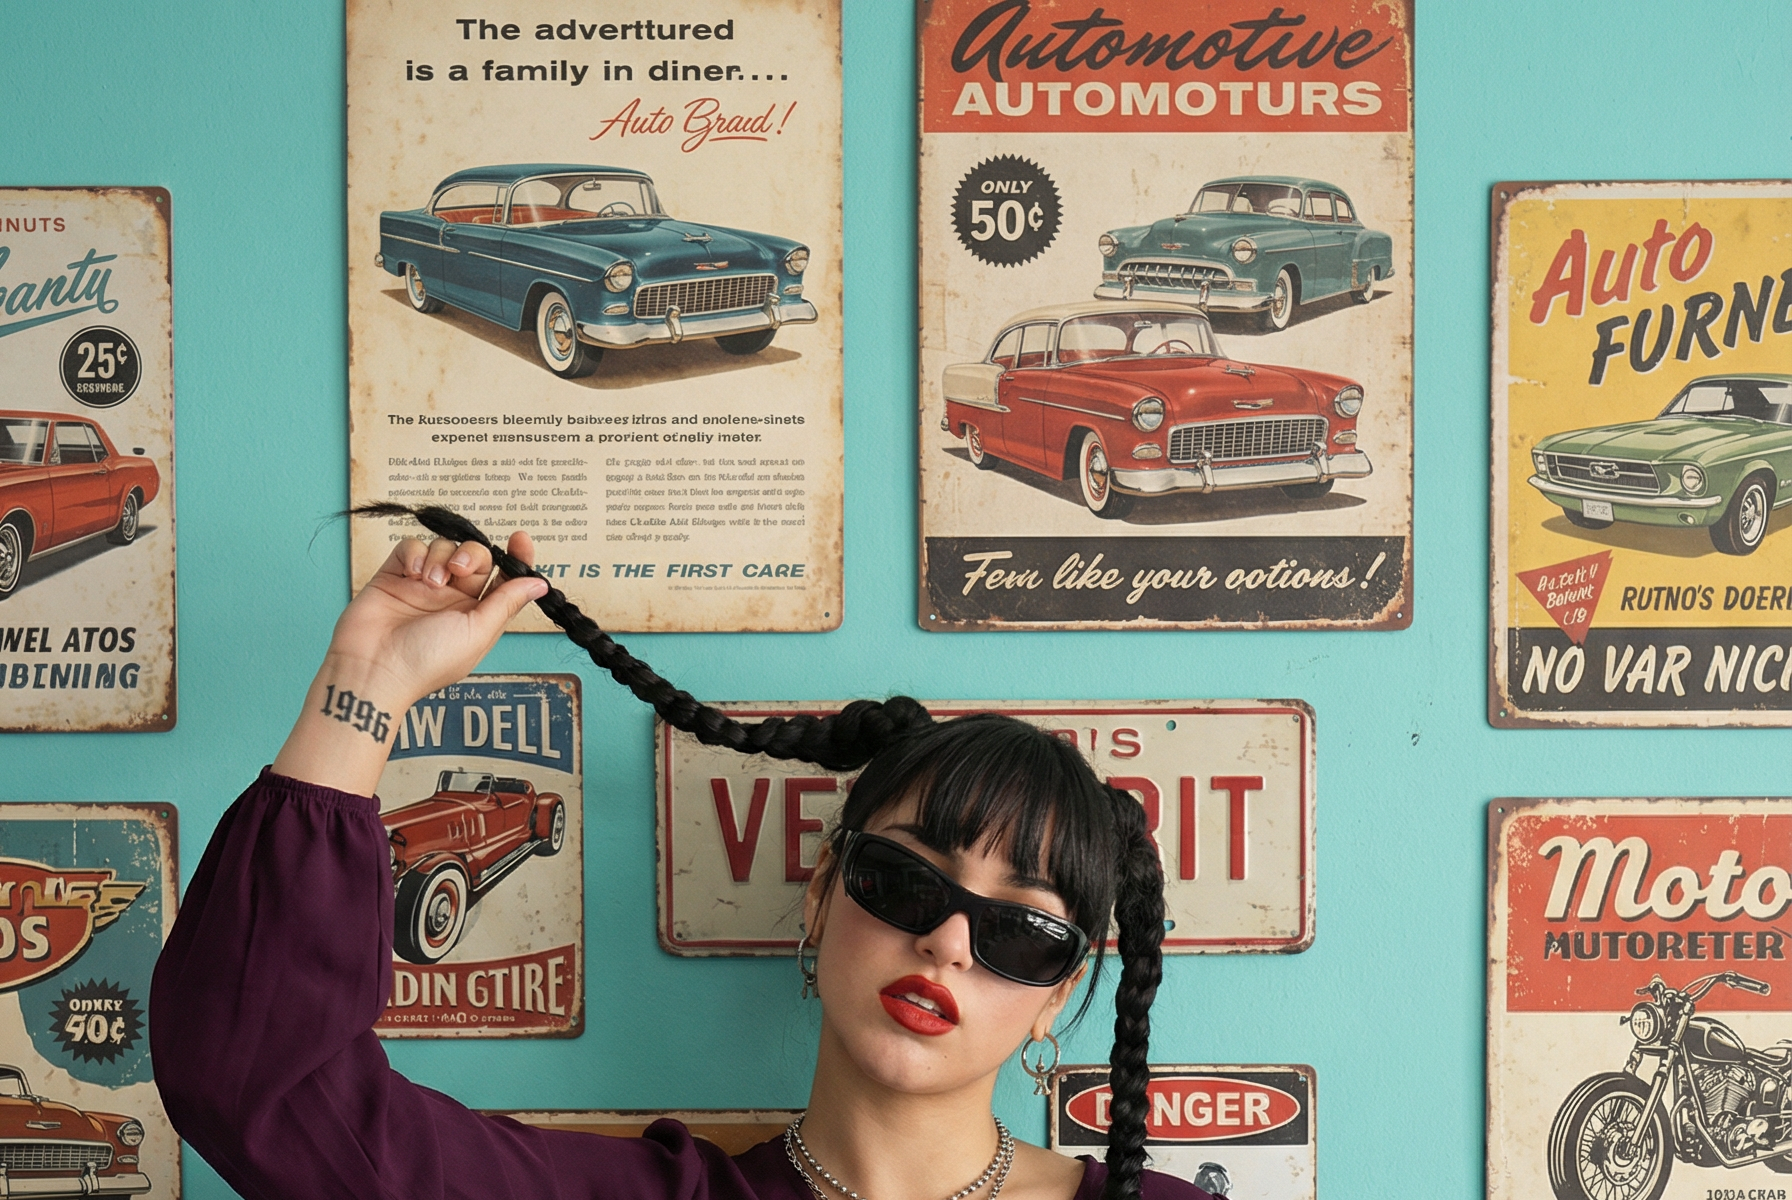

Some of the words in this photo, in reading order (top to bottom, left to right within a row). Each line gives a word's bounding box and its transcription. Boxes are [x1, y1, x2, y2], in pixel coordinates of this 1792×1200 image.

[456, 18, 522, 41] The
[534, 18, 735, 41] adverttured
[951, 0, 1394, 83] Automotive
[405, 59, 434, 82] is
[448, 64, 469, 82] a
[482, 60, 590, 87] family
[603, 59, 634, 82] in
[952, 81, 1383, 117] AUTOMOTURS
[589, 97, 674, 141] Auto
[980, 180, 1033, 194] ONLY
[970, 199, 1044, 242] 50¢
[1529, 218, 1715, 325] Auto
[77, 341, 128, 379] 25¢
[387, 414, 414, 425] The
[671, 414, 699, 425] and
[585, 433, 595, 443] a
[578, 563, 602, 578] IS
[612, 563, 656, 578] THE
[666, 563, 734, 578] FIRST
[742, 563, 806, 578] CARE
[1053, 552, 1124, 590] like
[1126, 564, 1217, 605] your
[1620, 584, 1715, 612] RUTNO'S
[1723, 585, 1792, 611] DOER
[61, 626, 137, 653] ATOS
[1522, 644, 1585, 694] NO
[1604, 644, 1692, 697] VAR
[321, 684, 392, 744] 1996
[462, 703, 562, 759] DELL
[1095, 1091, 1272, 1127] DNGER
